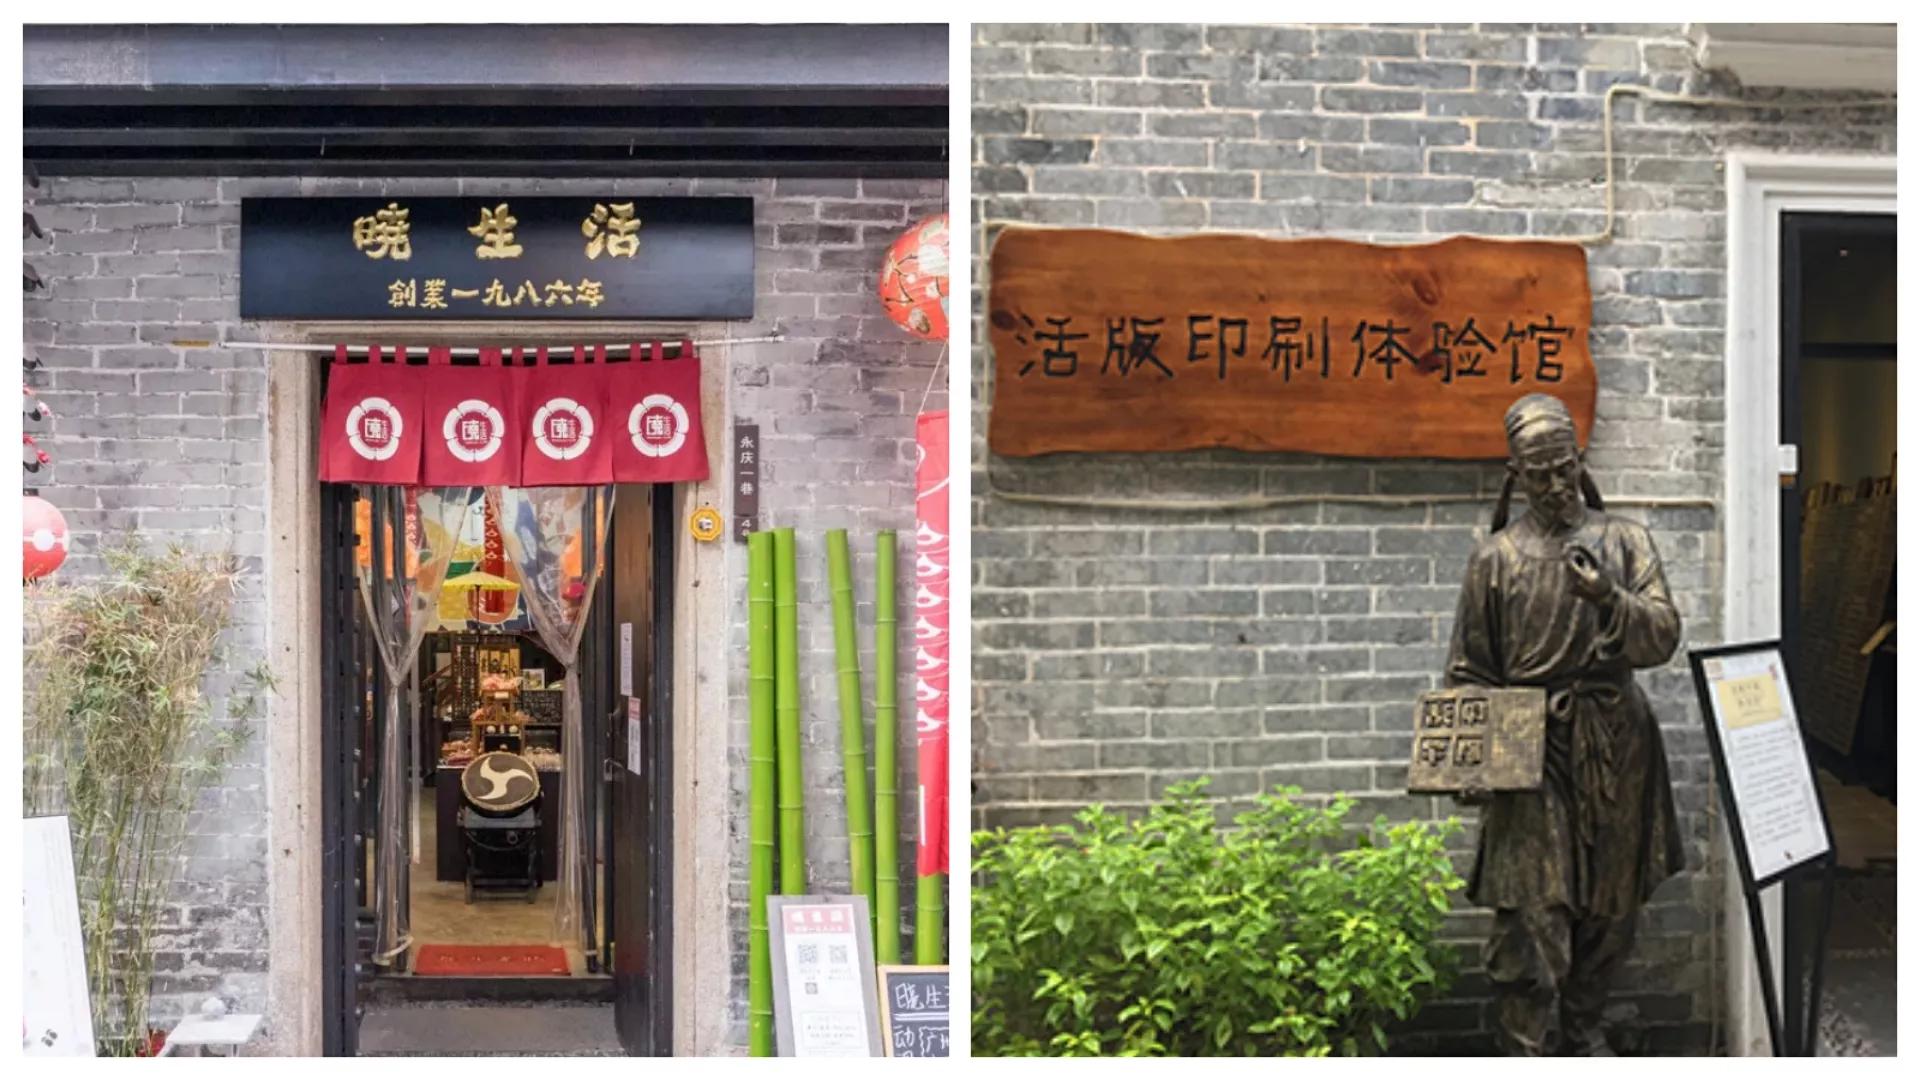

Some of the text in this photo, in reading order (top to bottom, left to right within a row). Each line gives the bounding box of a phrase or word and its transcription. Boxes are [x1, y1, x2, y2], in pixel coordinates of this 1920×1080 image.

[387, 278, 605, 309] 創業一九八六年
[1017, 313, 1574, 383] 活版印刷体验馆
[740, 436, 755, 495] 永庆一巷
